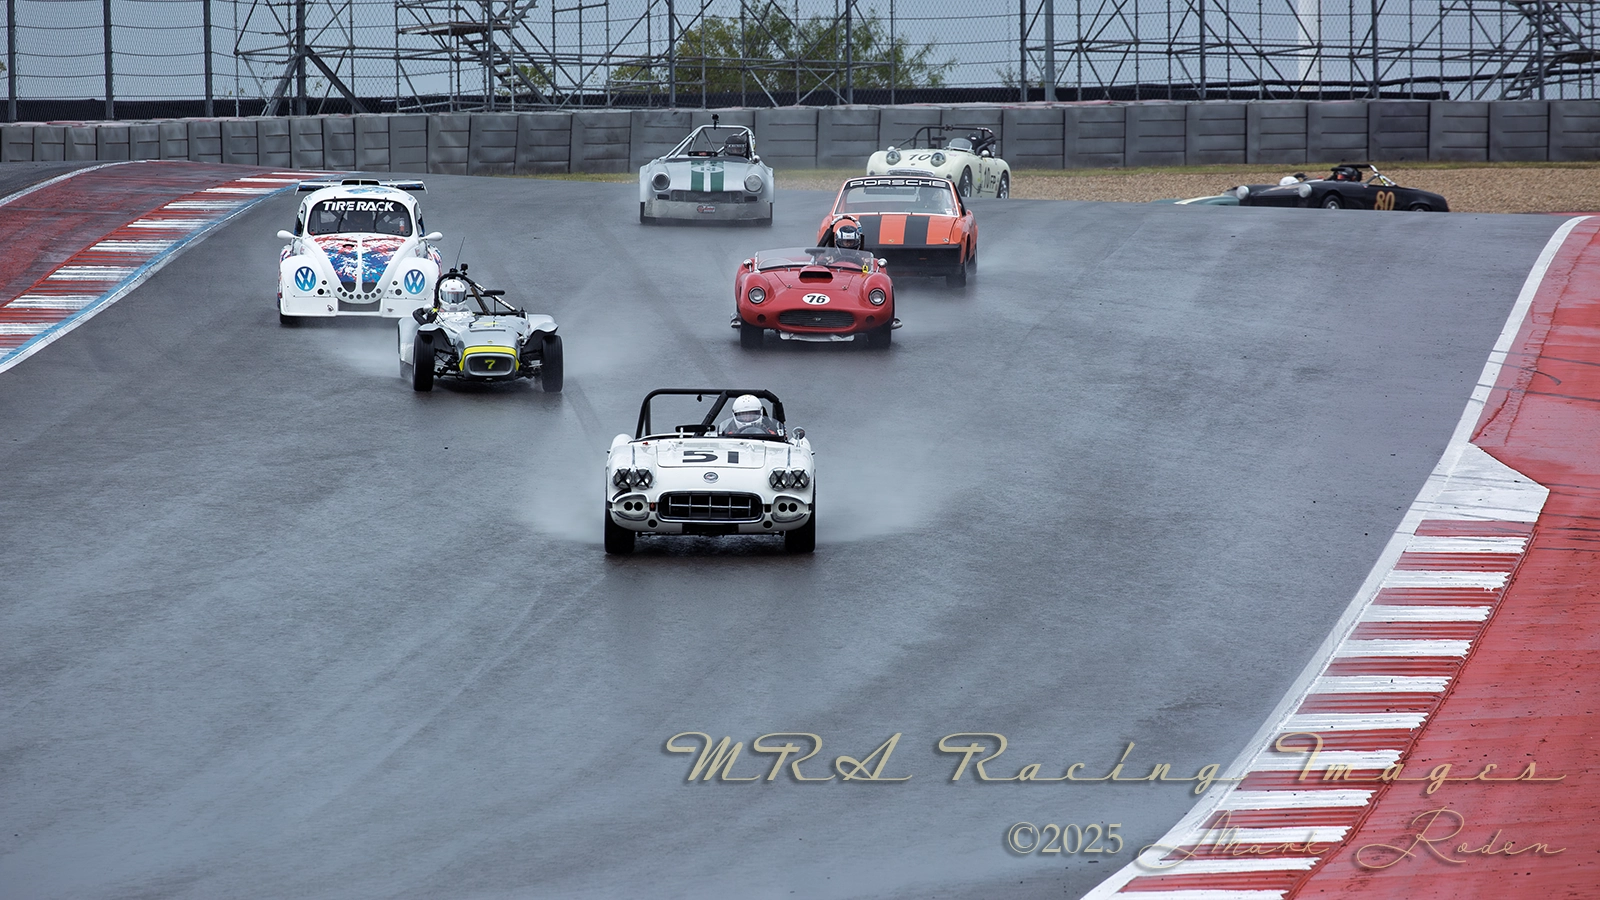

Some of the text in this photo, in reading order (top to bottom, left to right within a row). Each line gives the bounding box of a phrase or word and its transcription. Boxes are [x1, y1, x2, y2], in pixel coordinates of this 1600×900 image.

[908, 153, 931, 161] 10
[850, 179, 947, 188] PORSCHE
[1374, 191, 1395, 211] 80
[807, 294, 827, 304] 76
[484, 359, 496, 370] 7
[682, 450, 739, 464] 51
